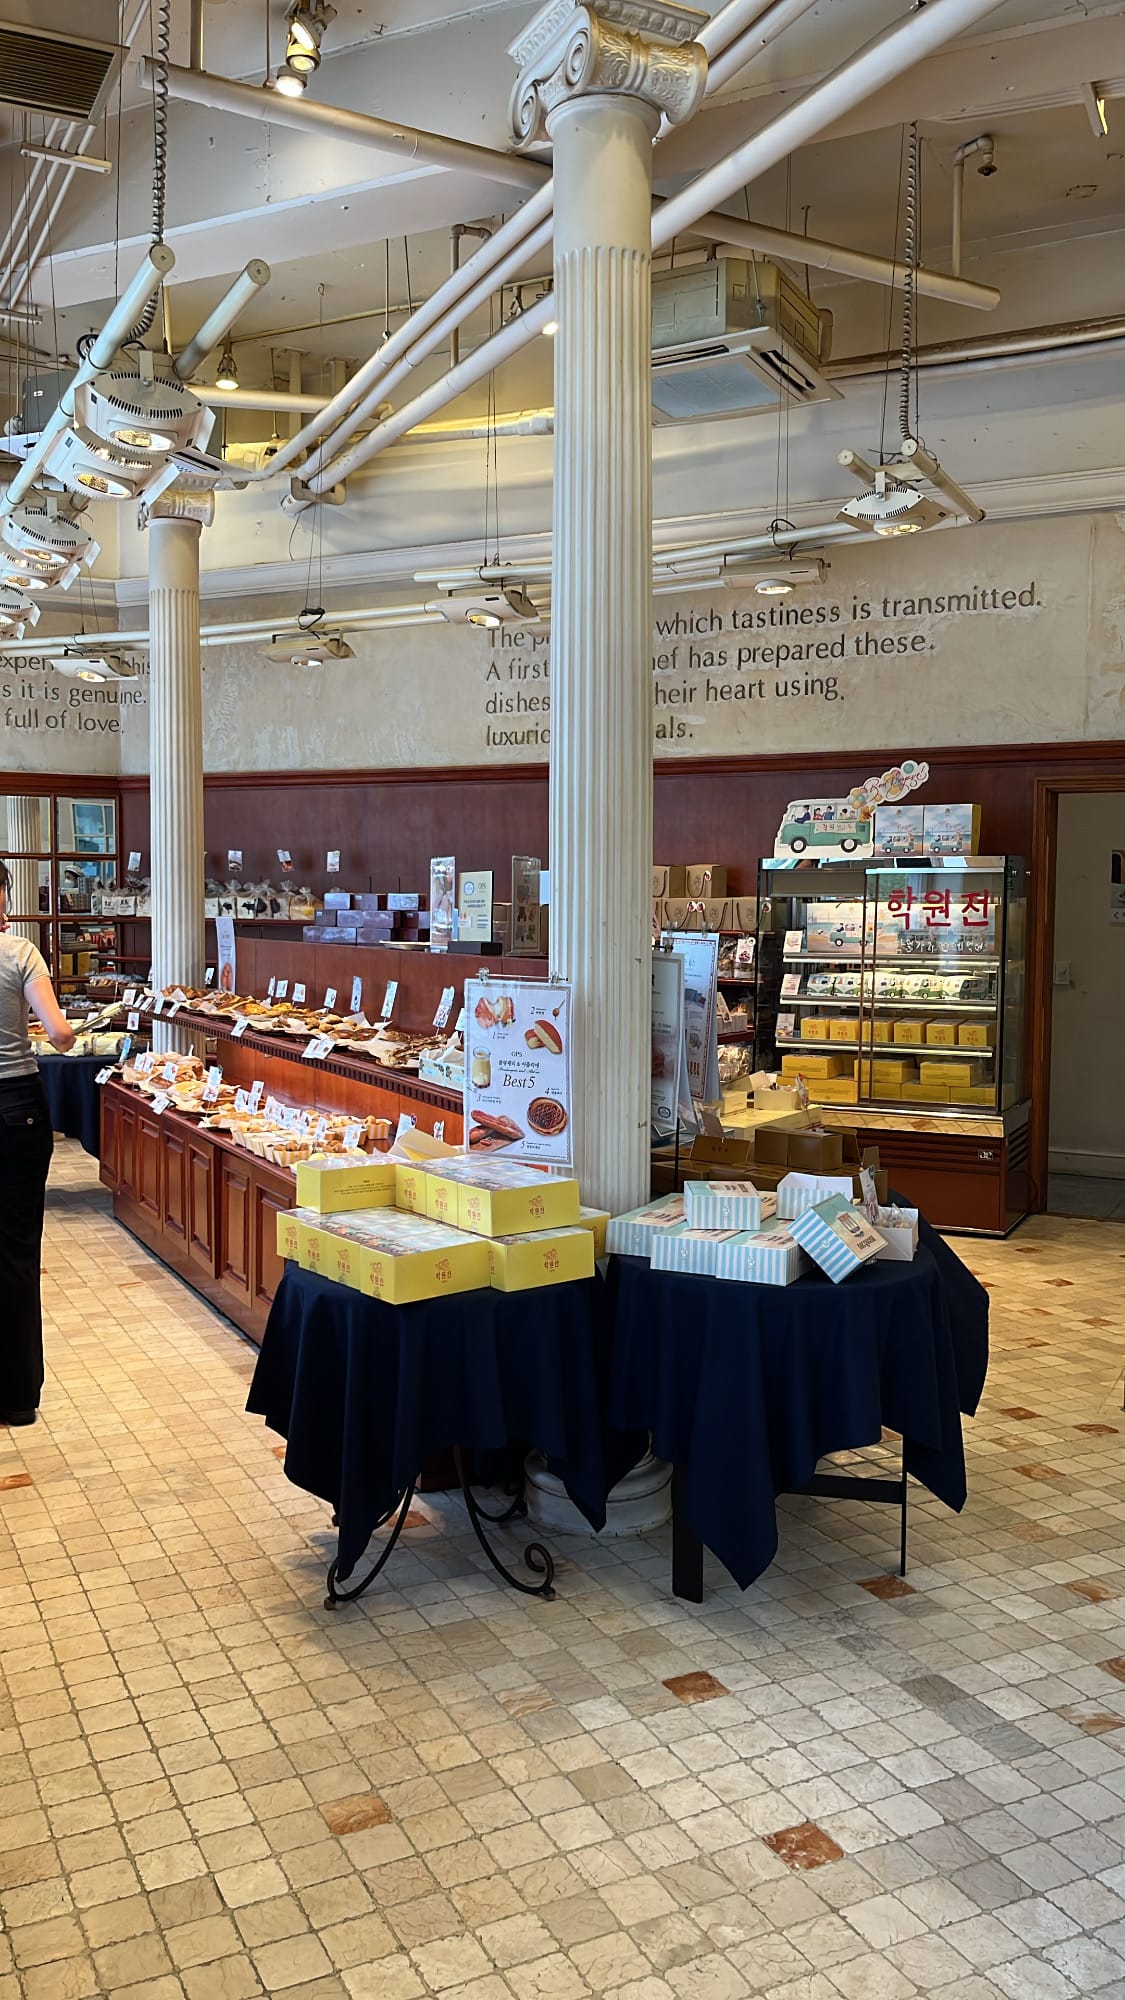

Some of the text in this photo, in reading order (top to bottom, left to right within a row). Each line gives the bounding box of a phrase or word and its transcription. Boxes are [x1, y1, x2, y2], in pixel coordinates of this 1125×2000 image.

[655, 581, 1042, 636] which tastiness is transmitted.
[487, 628, 525, 649] The
[652, 631, 936, 671] ef has prepared these.
[486, 656, 550, 682] A first
[21, 679, 34, 699] it
[44, 681, 60, 701] is
[69, 687, 147, 708] genuine.
[655, 671, 845, 705] heir heart using.
[485, 690, 550, 715] dishes
[5, 707, 125, 734] full of love.
[655, 714, 694, 740] als.
[486, 721, 550, 747] luxurio
[887, 885, 990, 931] 학원전
[503, 1073, 536, 1089] Best 5
